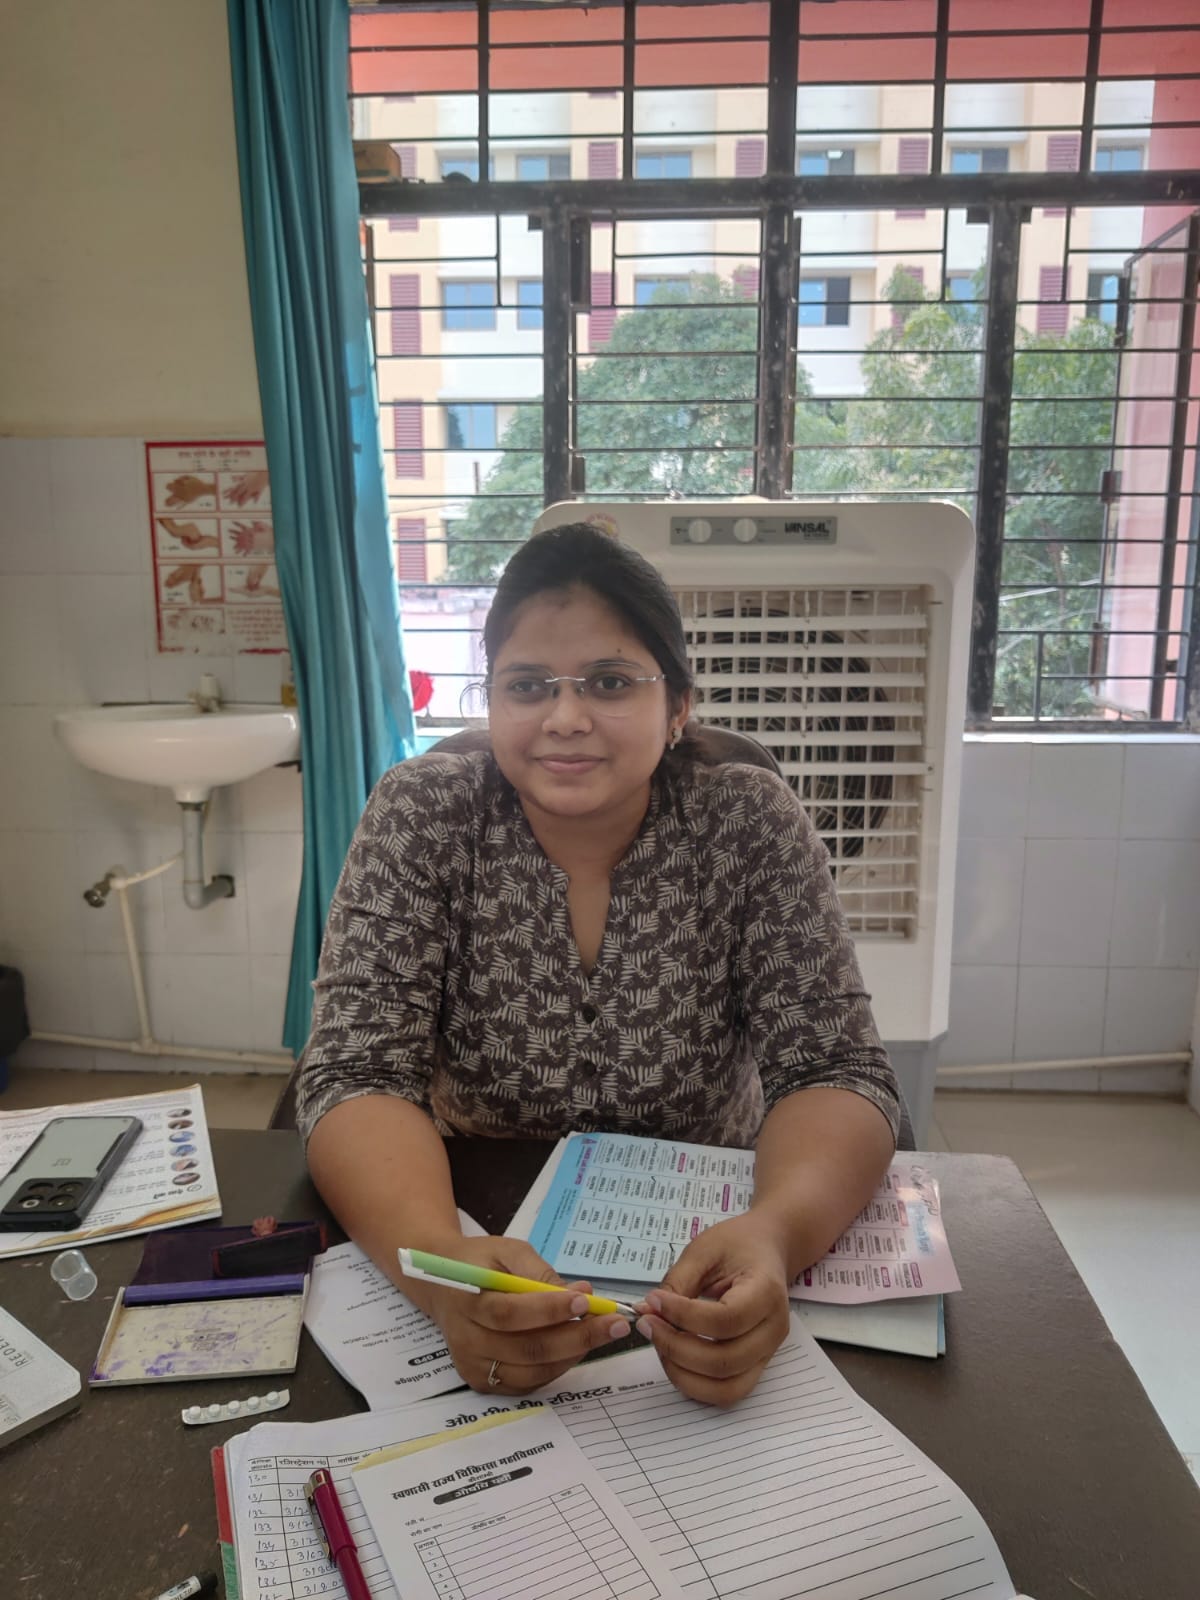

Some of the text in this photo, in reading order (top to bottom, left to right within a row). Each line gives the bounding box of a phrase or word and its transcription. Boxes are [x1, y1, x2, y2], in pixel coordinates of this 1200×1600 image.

[394, 1371, 431, 1386] College
[548, 1385, 614, 1406] रजिस्टर
[432, 1475, 456, 1488] राज्य
